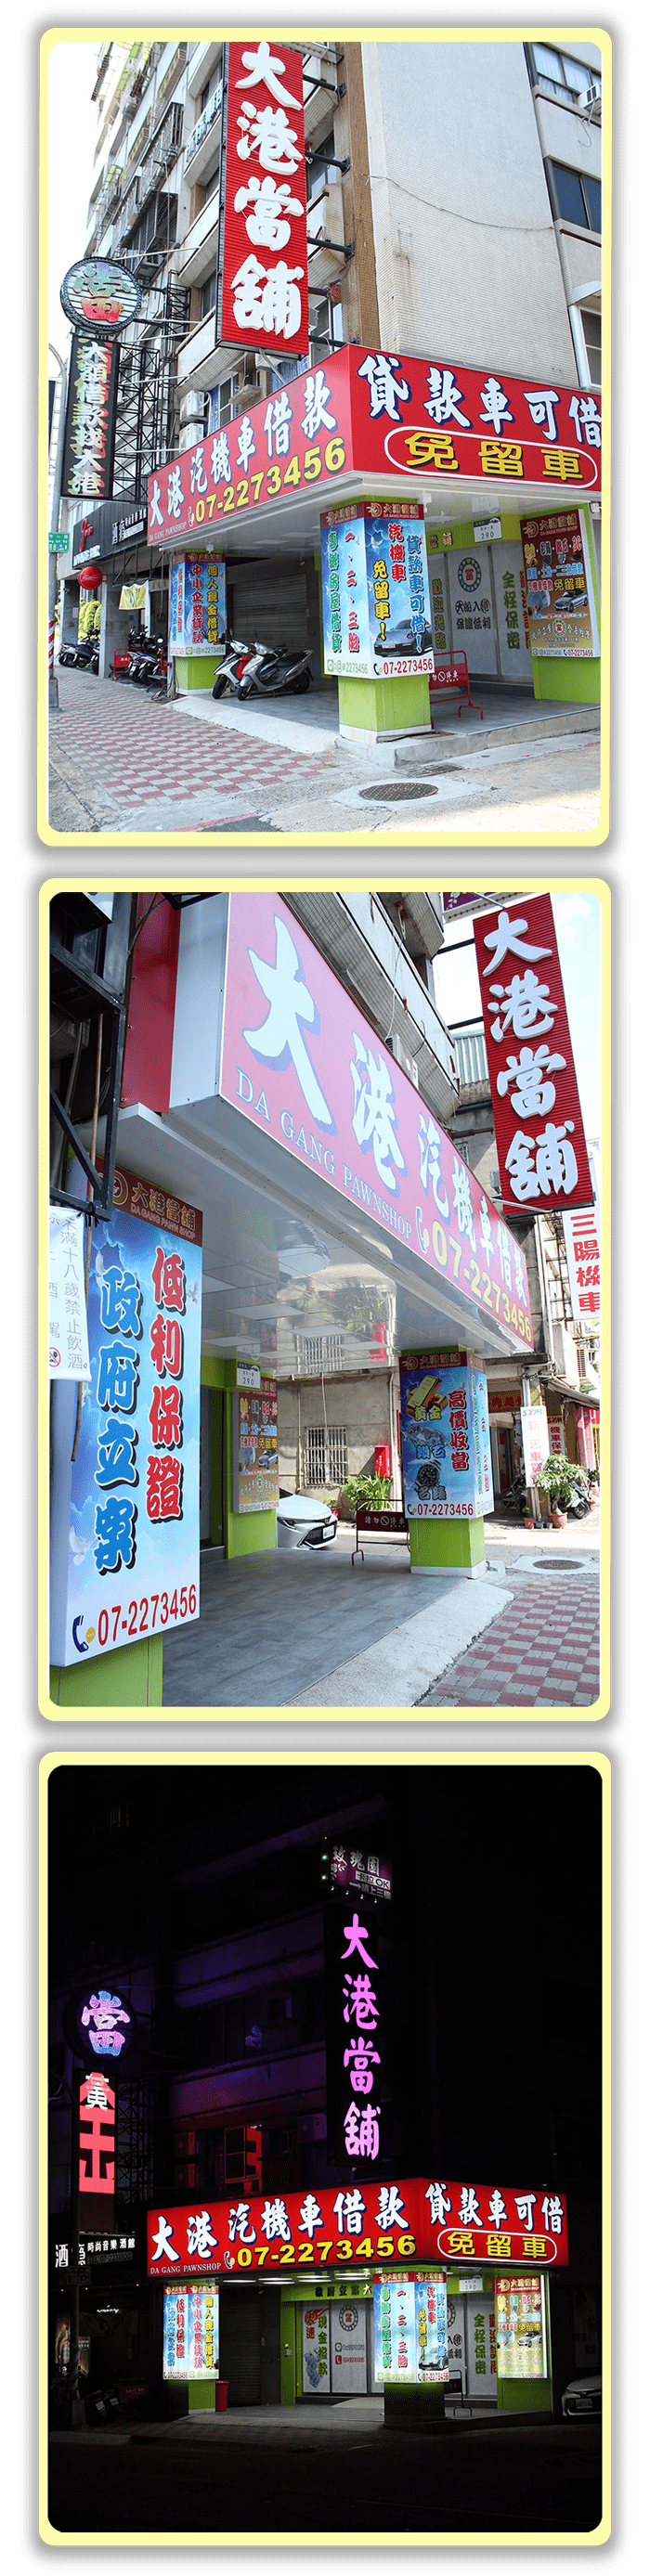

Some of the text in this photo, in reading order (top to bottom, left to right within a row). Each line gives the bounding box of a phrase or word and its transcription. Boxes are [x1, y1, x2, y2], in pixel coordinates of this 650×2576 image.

[230, 42, 305, 340] 大港當舖
[72, 261, 132, 323] 當
[358, 354, 602, 447] 貸款車可借
[150, 369, 338, 528] 大港汽機車借款
[404, 432, 584, 481] 免留車
[196, 436, 346, 523] 07-2273456
[388, 523, 406, 582] 汽機車
[481, 531, 494, 539] 290
[553, 577, 585, 591] 免留車
[383, 658, 434, 675] 07-2273456
[482, 911, 578, 1203] 大港當舖
[235, 1066, 412, 1242] DA GANG PAWNSHOP
[132, 1183, 196, 1231] 大港當舖
[432, 1219, 532, 1343] 07-2273456
[570, 1213, 600, 1313] 三陽機車
[146, 1247, 184, 1521] 低利保證
[242, 1378, 254, 1386] 290
[94, 1265, 141, 1574] 政府立案
[414, 1405, 442, 1421] 黃金
[448, 1390, 469, 1471] 高價收當
[522, 1408, 543, 1417] SYM
[547, 1416, 564, 1424] SYM
[418, 1503, 474, 1516] 07-2273456
[98, 1583, 197, 1647] 07-2273456
[332, 1845, 380, 1876] 玫瑰園
[81, 1990, 131, 2057] 當
[340, 1912, 382, 2161] 大港當舖
[151, 2185, 410, 2262] 大港汽機車借款
[424, 2181, 565, 2234] 貸款車可借
[162, 2265, 181, 2273] GANG
[183, 2262, 221, 2272] PAWNSHOP
[237, 2233, 416, 2268] 07-2273456
[447, 2231, 548, 2259] 免留車
